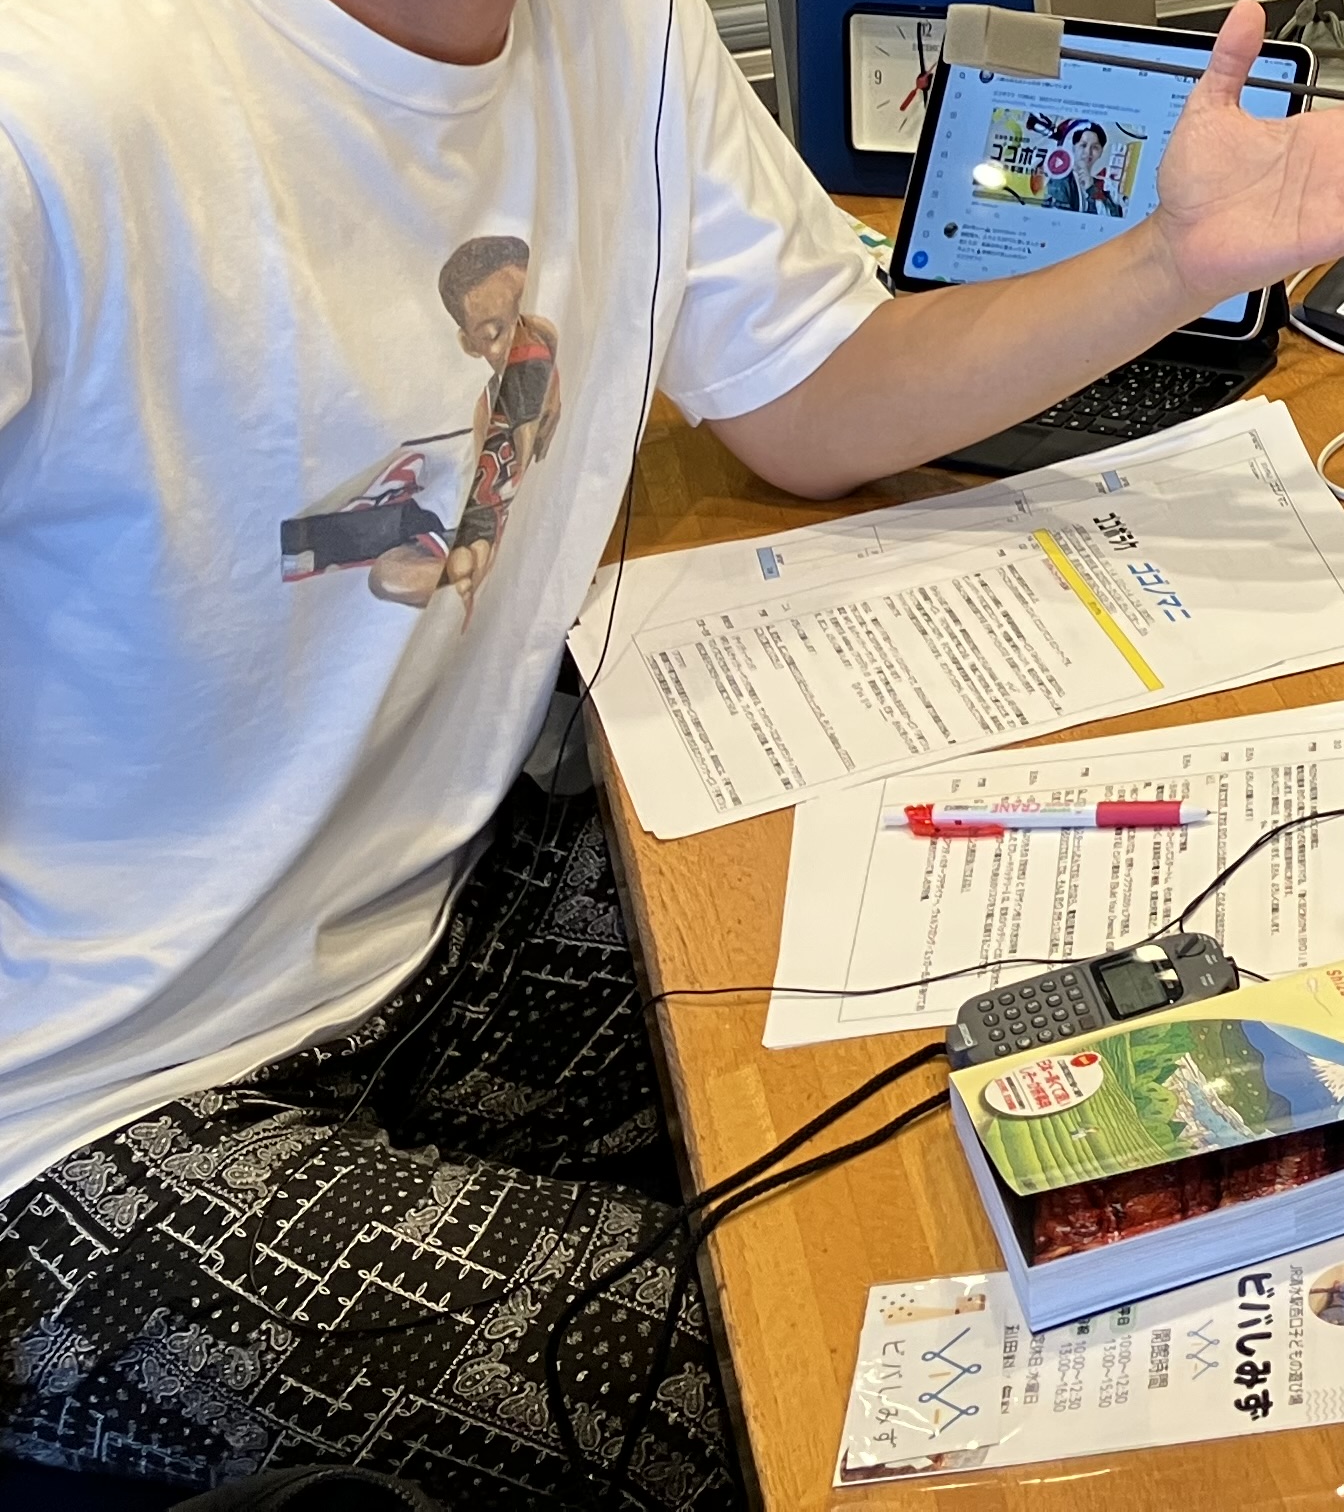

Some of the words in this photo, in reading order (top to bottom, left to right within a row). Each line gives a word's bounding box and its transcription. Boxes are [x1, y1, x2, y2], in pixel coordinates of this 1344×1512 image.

[874, 69, 882, 85] 9
[1126, 559, 1193, 622] ゴゴノマニ
[1145, 1327, 1171, 1391] 開館時間
[1230, 1269, 1275, 1424] ビバしみず
[861, 1337, 915, 1453] ビバしみず
